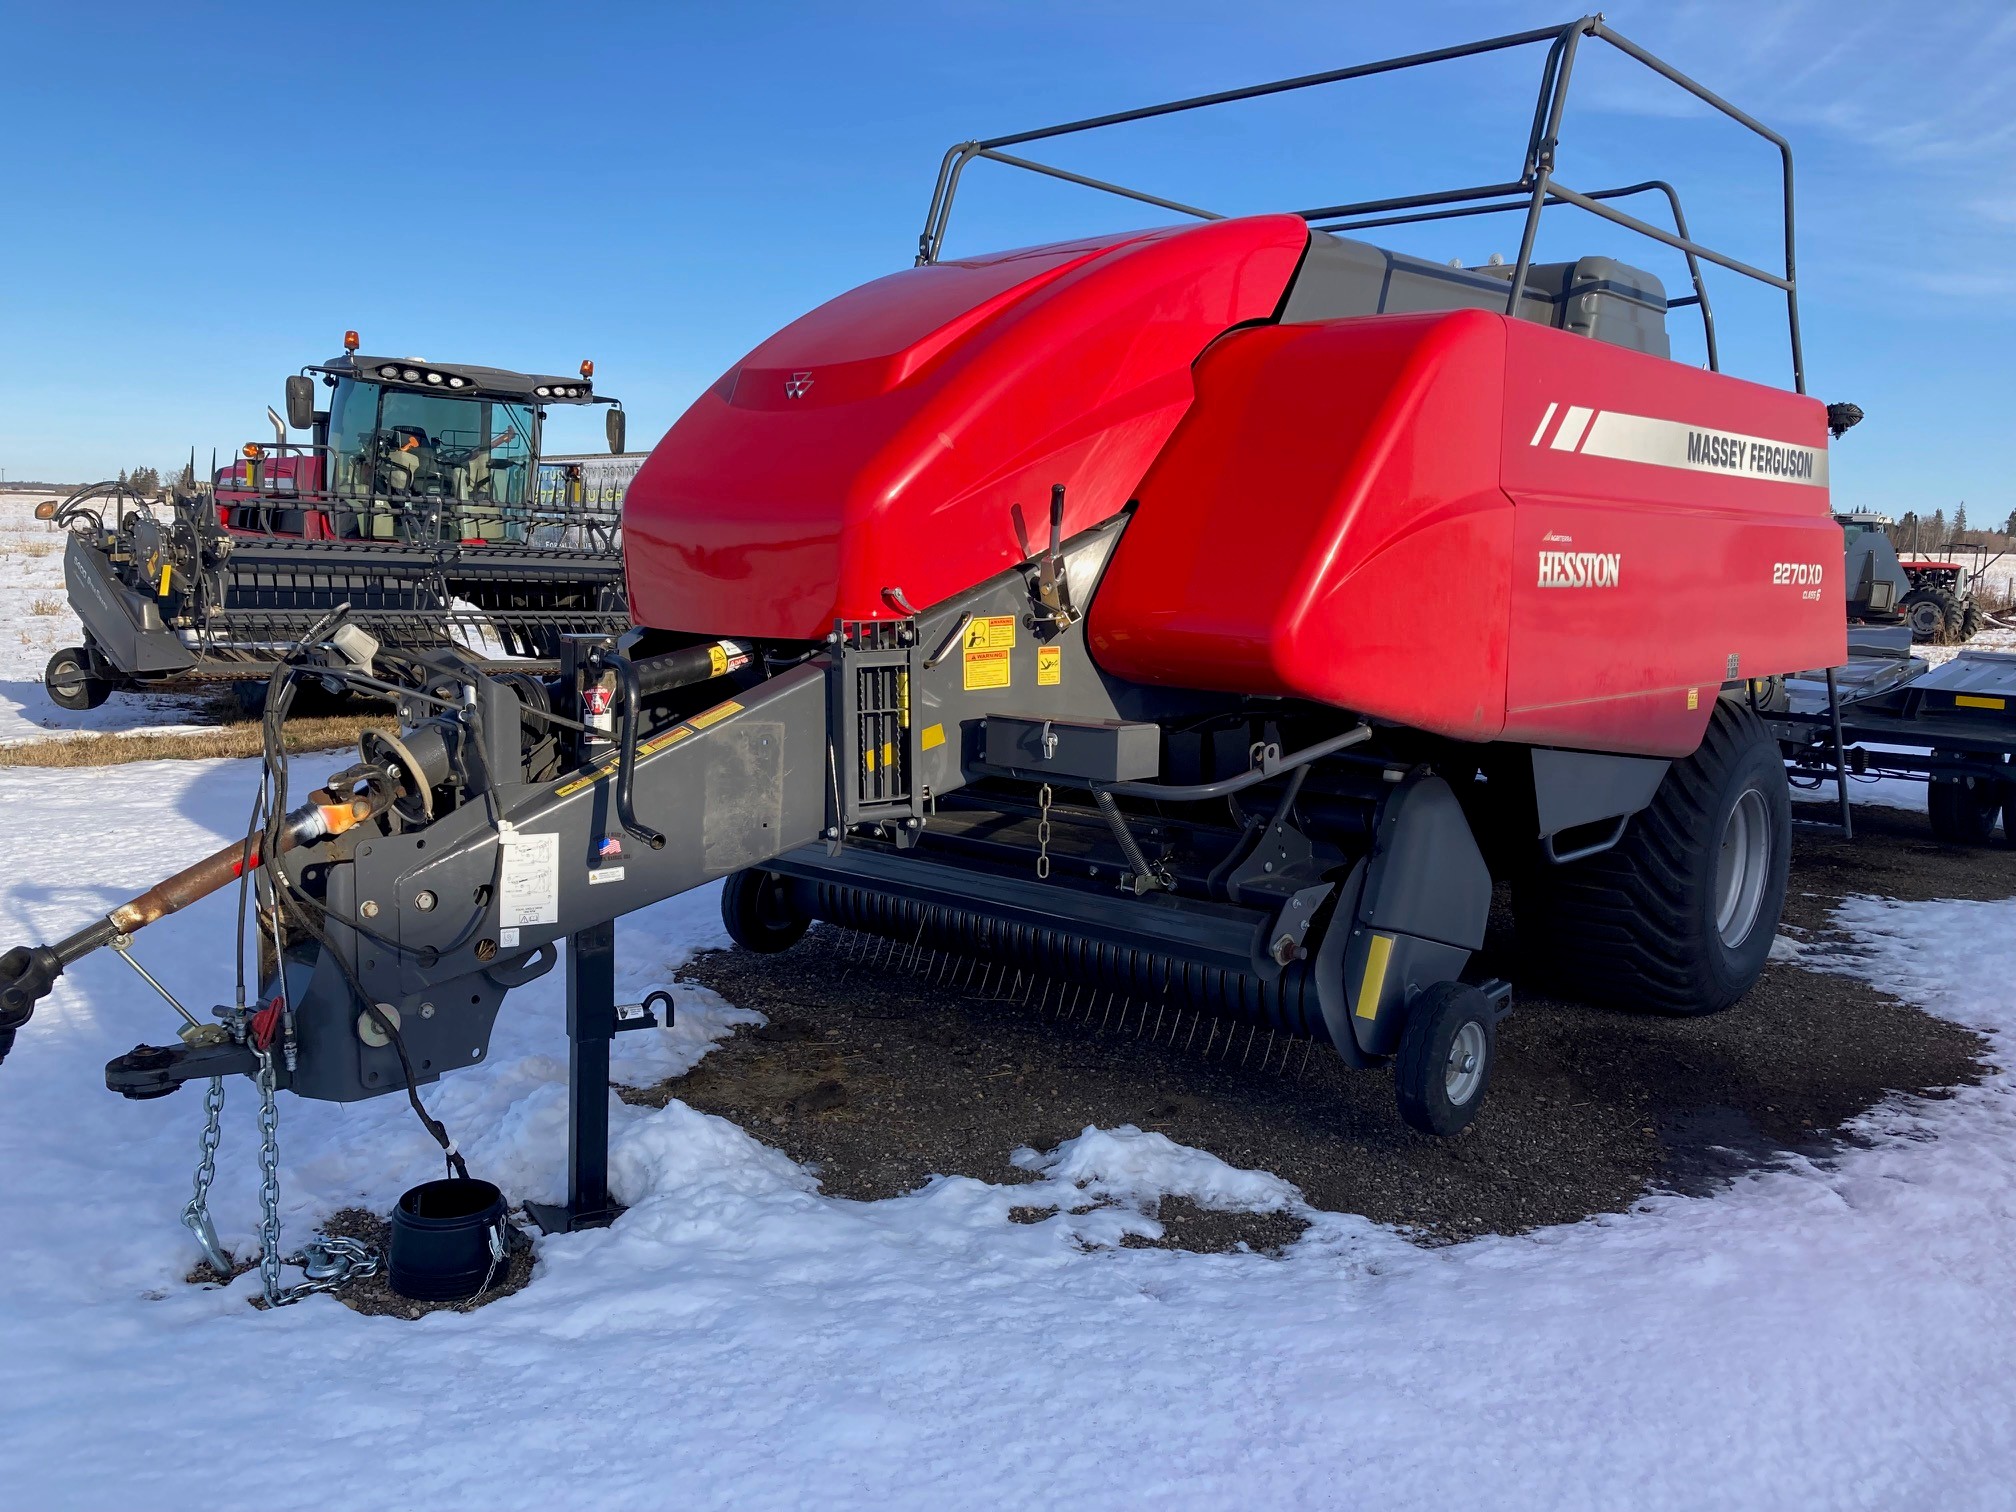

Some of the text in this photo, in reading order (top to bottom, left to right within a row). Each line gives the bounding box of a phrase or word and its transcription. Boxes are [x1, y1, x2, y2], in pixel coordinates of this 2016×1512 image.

[1687, 431, 1813, 478] MASSEY FERGUSON
[1537, 551, 1621, 588] HESSTON
[1773, 562, 1823, 585] 2270XD
